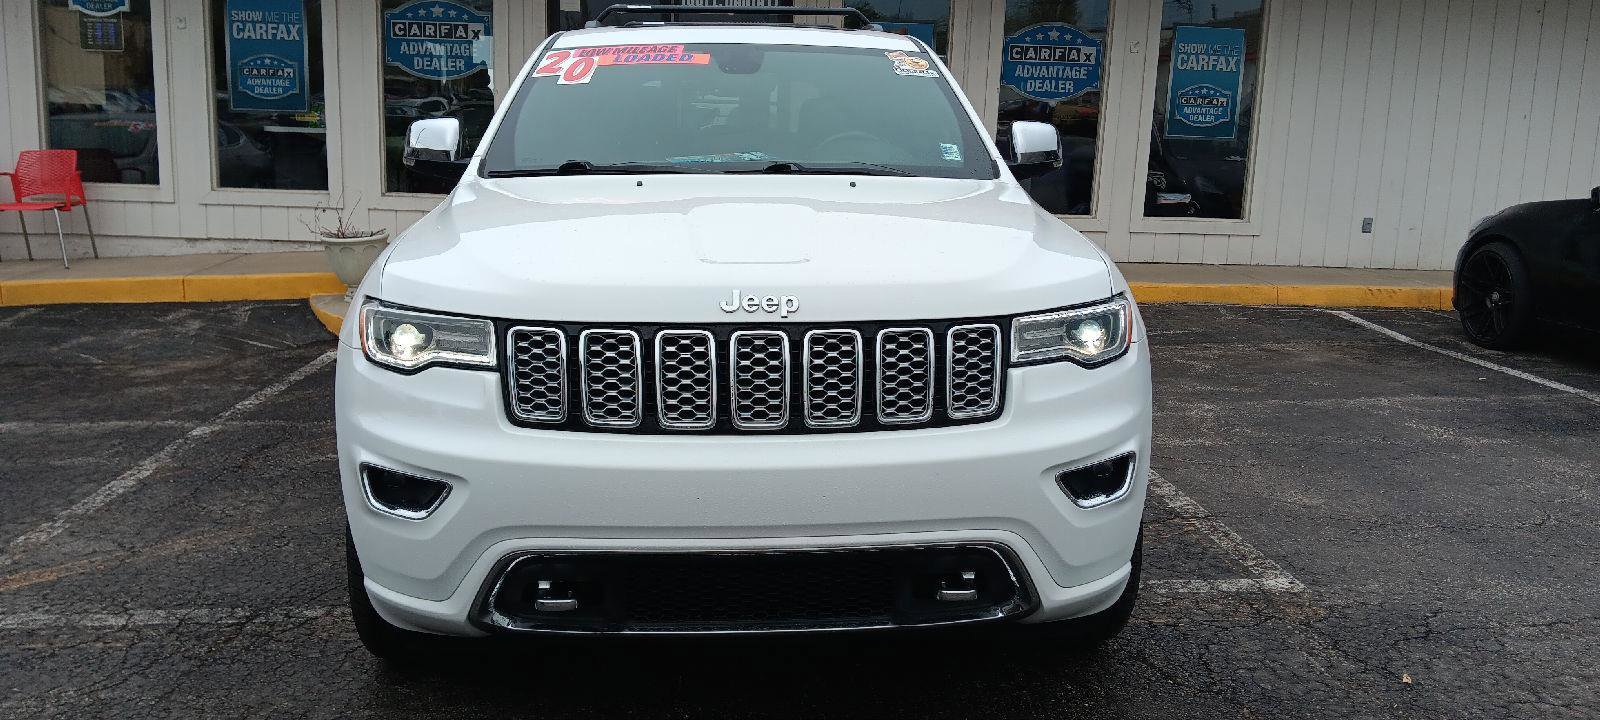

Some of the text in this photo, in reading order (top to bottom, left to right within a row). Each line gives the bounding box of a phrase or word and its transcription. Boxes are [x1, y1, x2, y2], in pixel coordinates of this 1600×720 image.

[231, 10, 300, 23] SHOW ME THE
[232, 22, 300, 40] CARFAX
[394, 23, 482, 41] CARFAX
[400, 41, 478, 57] ADVANTAGE
[579, 45, 679, 57] LOW MILEAGE
[1011, 47, 1094, 63] CARFAX
[1178, 42, 1240, 56] SHOW ME THE
[413, 56, 465, 71] DEALER
[613, 53, 695, 64] LOADED
[1177, 54, 1238, 72] CARFAX
[243, 68, 294, 78] CARFAX
[1014, 64, 1089, 79] ADVANTAGE
[246, 78, 290, 87] ADVANTAGE
[1026, 80, 1074, 93] DEALER
[254, 86, 283, 95] DEALER
[1181, 96, 1228, 107] CARFAX
[1183, 106, 1223, 115] ADVANTAGE
[1189, 114, 1215, 122] DEALER
[719, 289, 800, 318] Jeep
